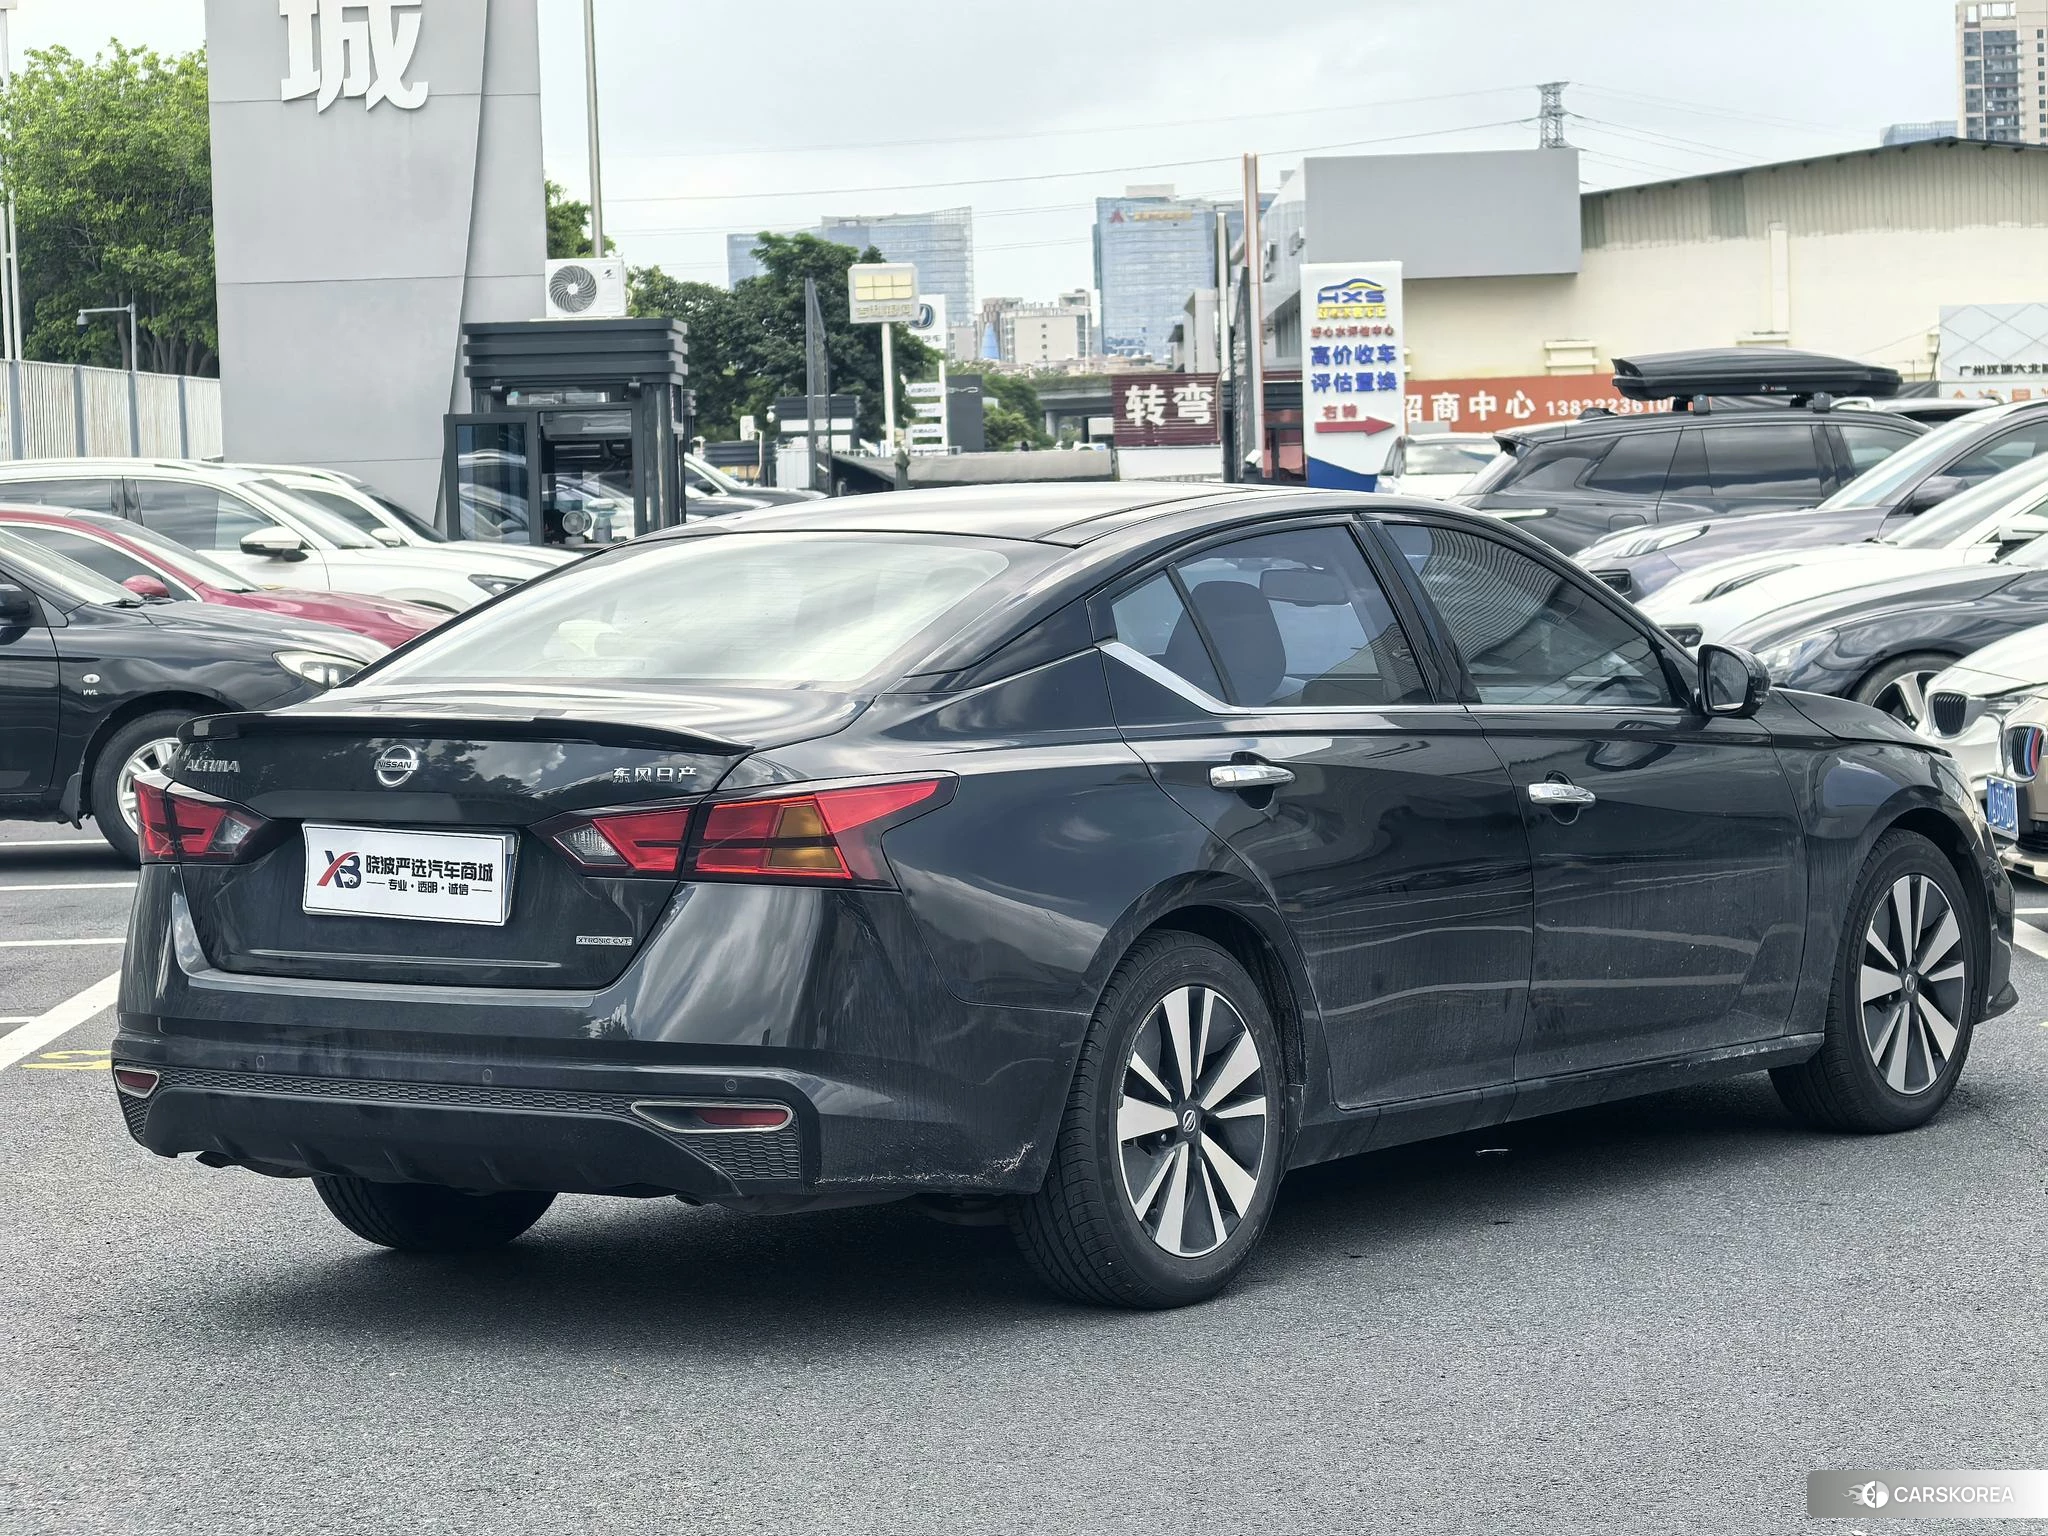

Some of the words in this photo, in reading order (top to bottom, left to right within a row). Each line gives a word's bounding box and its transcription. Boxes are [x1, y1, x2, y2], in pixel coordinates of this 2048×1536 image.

[1310, 344, 1396, 366] 高价收车
[1310, 371, 1397, 393] 评估置换
[1125, 383, 1214, 427] 转弯
[184, 759, 241, 773] ALTIMA
[379, 761, 412, 769] NISSAN
[613, 766, 697, 783] 东风日产
[366, 854, 494, 882] 晓波严选汽车商城
